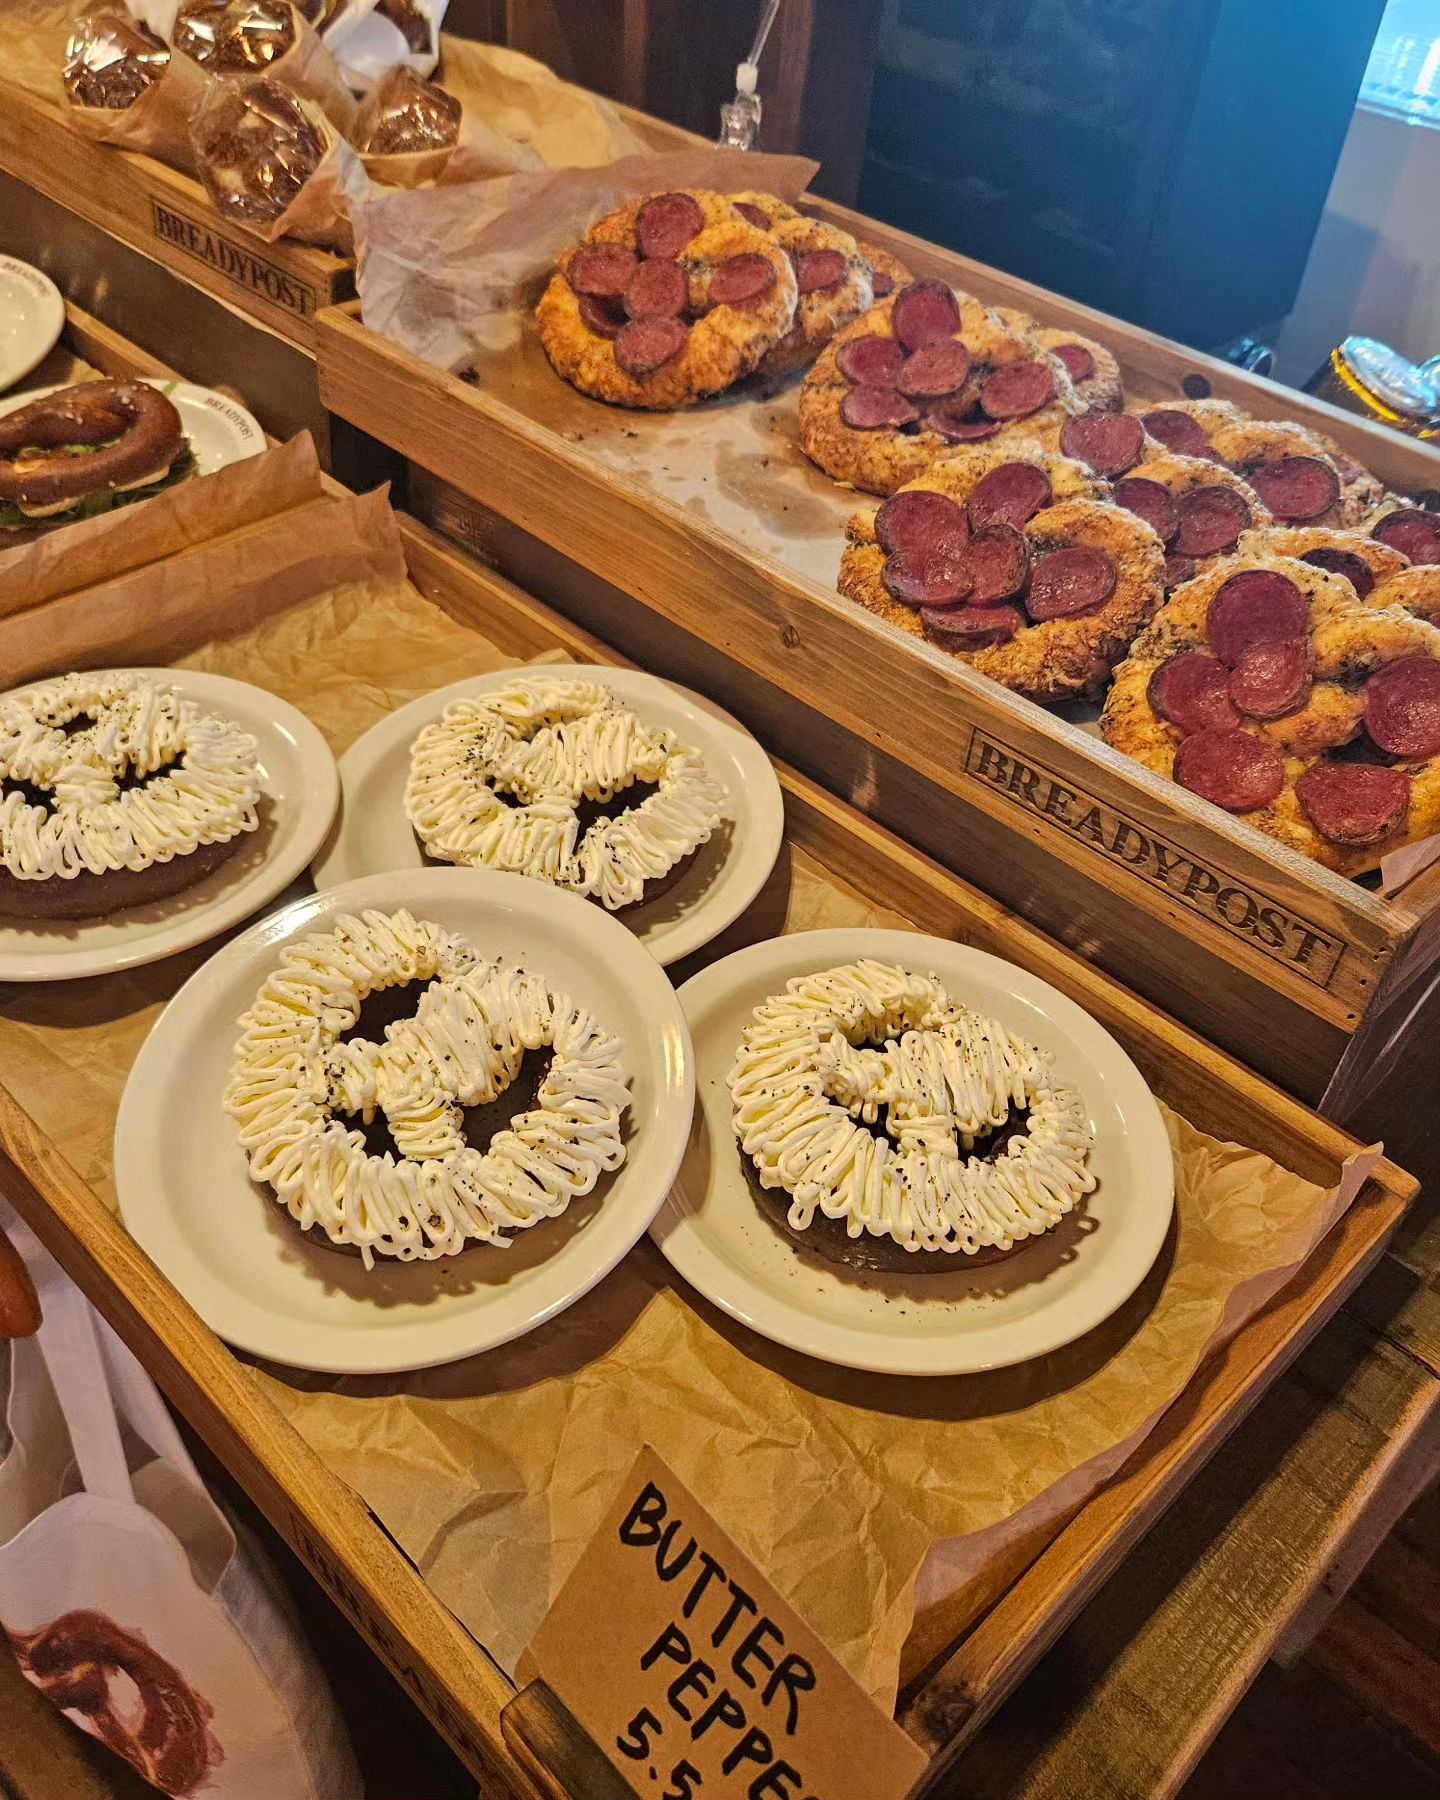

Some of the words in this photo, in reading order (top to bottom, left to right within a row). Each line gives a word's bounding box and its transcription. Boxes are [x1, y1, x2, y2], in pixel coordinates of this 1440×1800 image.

[158, 207, 311, 314] BREADYPOST
[976, 740, 1332, 965] BREADYPOST
[618, 1481, 816, 1735] BUTTER
[640, 1621, 820, 1800] PEPPE
